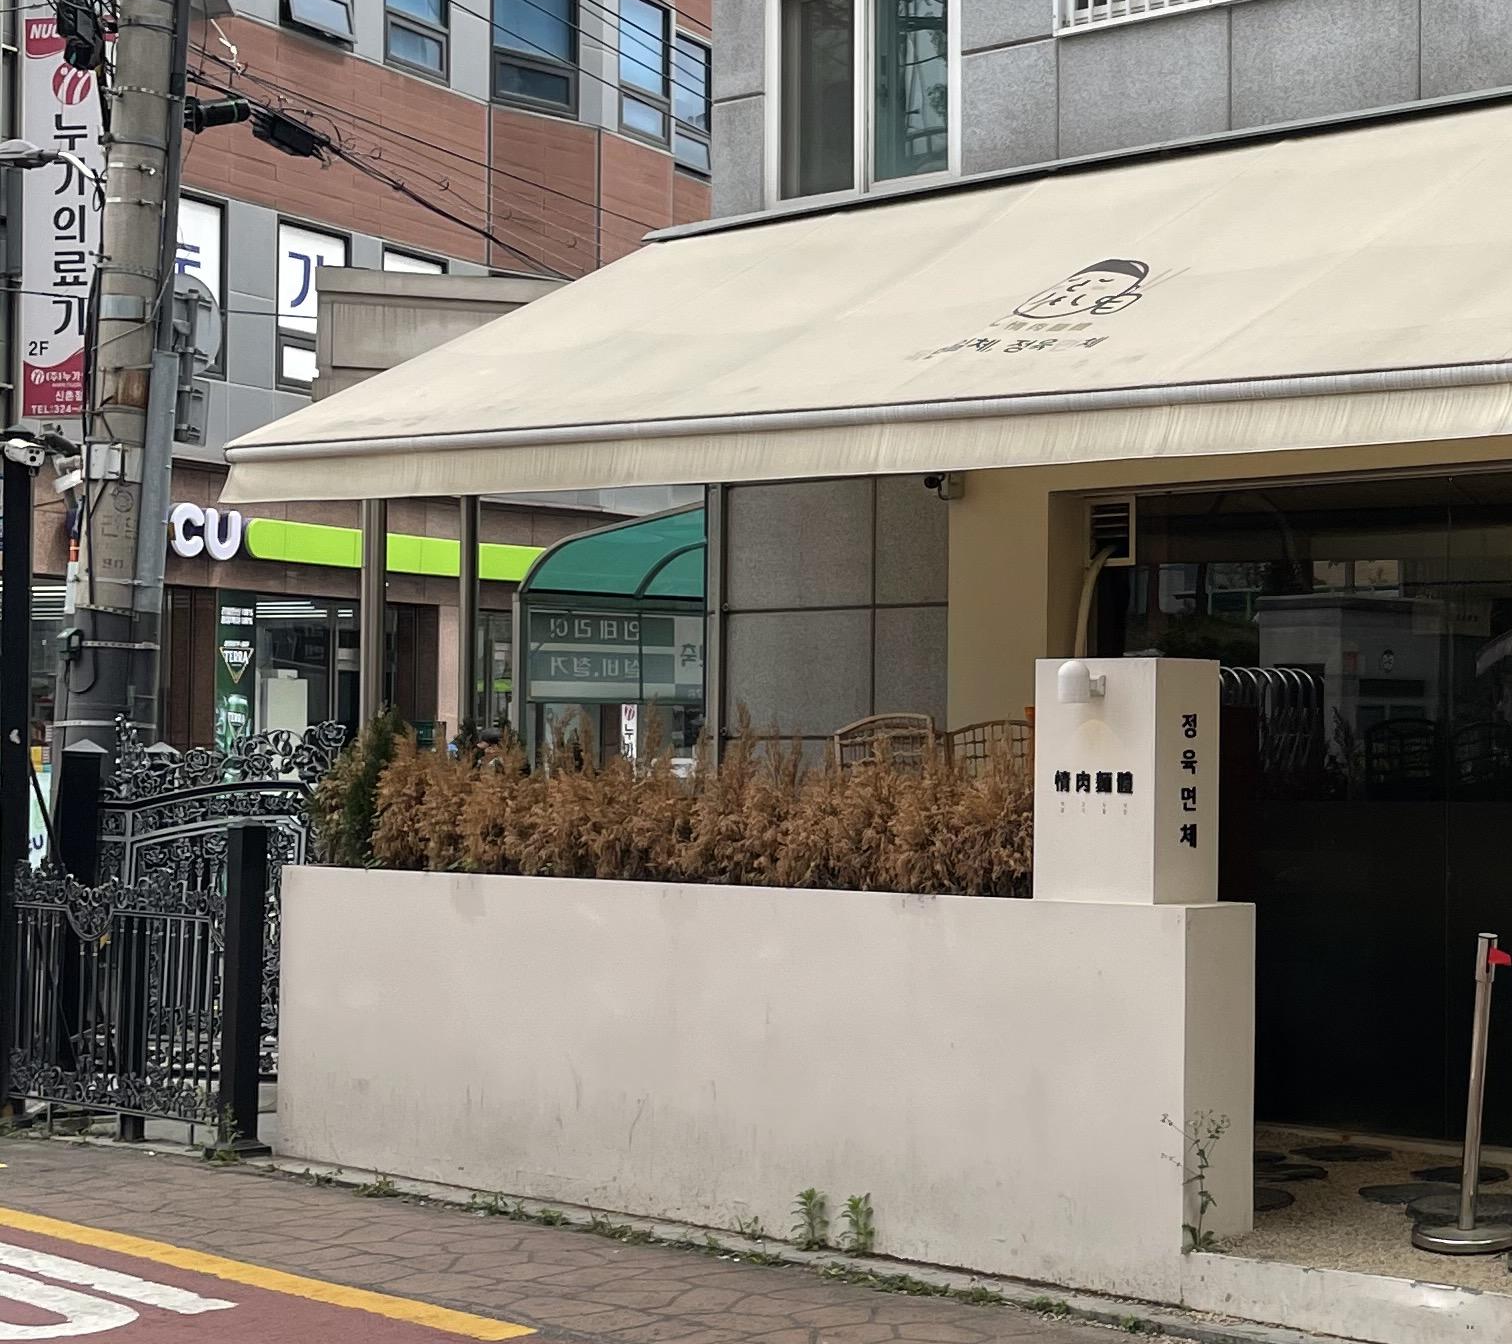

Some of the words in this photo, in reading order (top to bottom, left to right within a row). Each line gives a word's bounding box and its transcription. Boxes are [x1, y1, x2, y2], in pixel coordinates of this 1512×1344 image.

[53, 113, 89, 337] 누가의료기
[28, 340, 49, 356] 2F
[168, 502, 242, 561] CU
[1179, 713, 1198, 849] 정육면체
